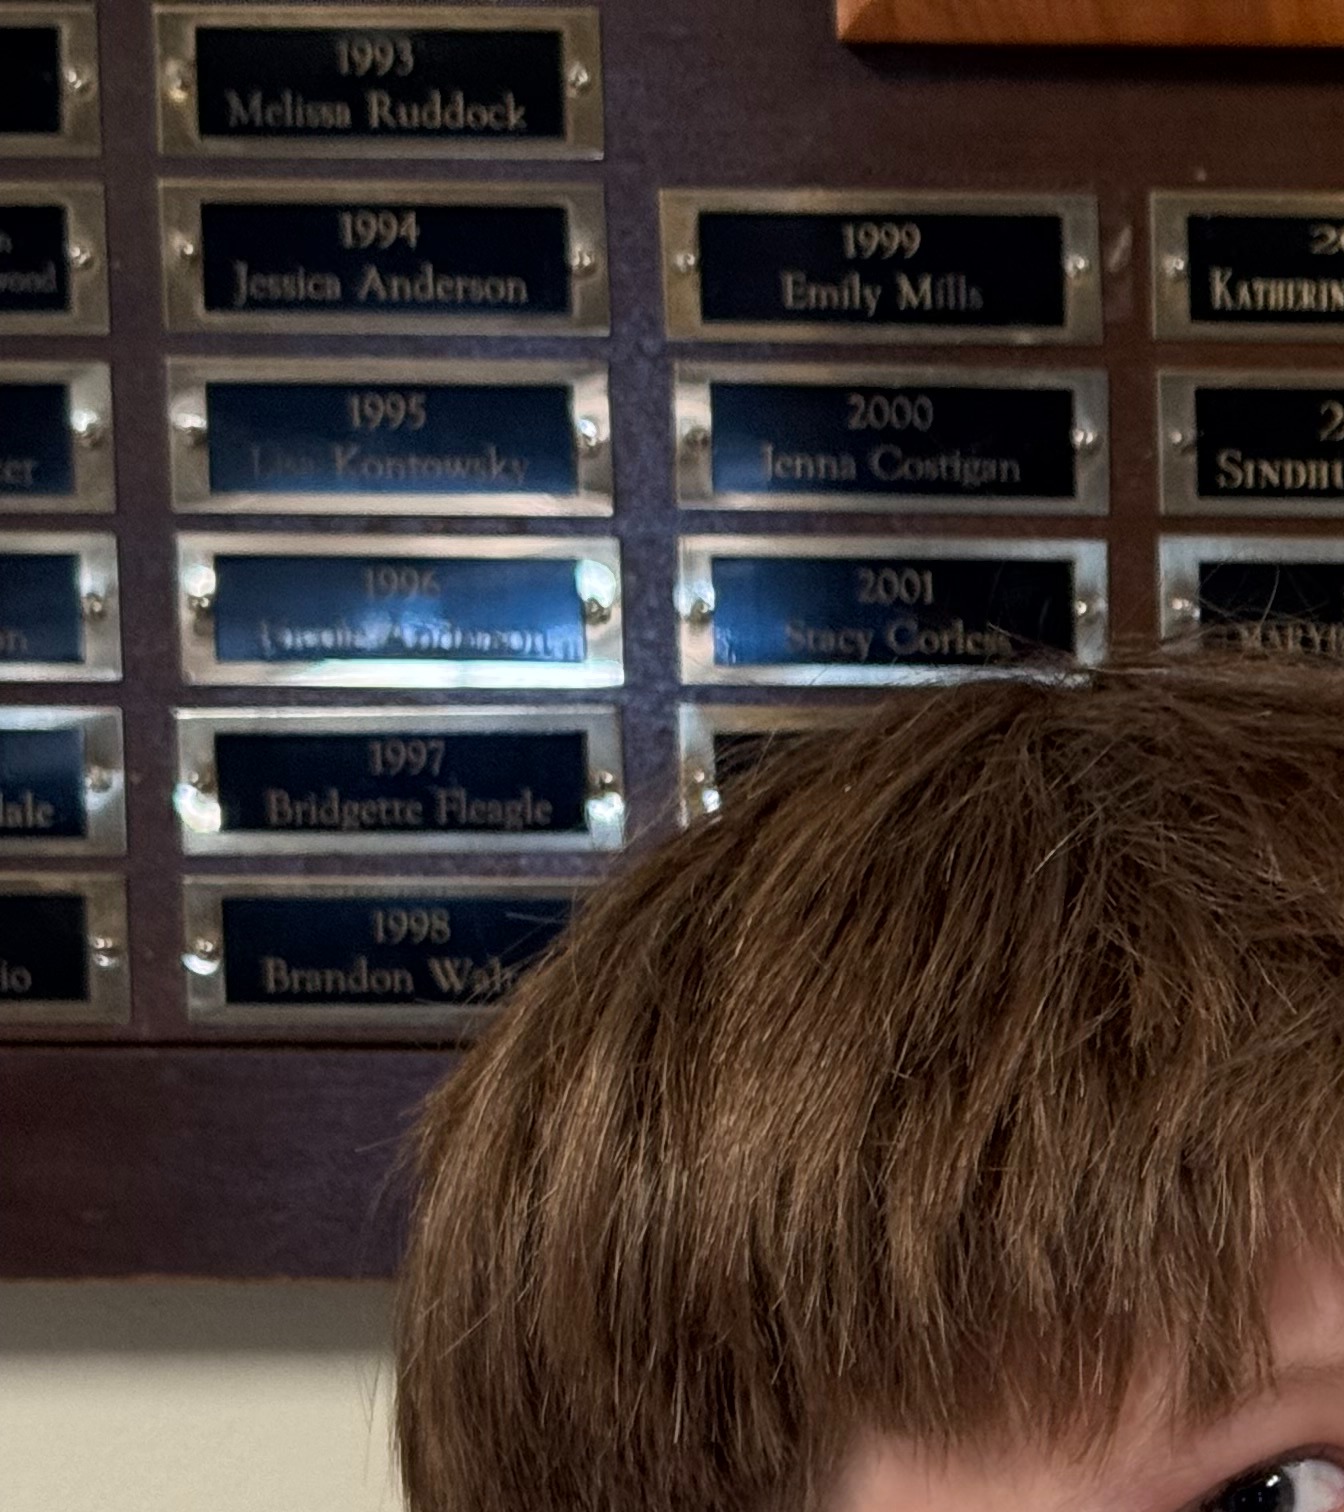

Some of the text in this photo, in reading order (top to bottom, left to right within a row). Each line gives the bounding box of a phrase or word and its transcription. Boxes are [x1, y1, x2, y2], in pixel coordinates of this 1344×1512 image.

[337, 38, 415, 77] 1993
[226, 89, 529, 131] Melissa Ruddock
[338, 209, 421, 250] 1994
[840, 221, 922, 260] 1999
[233, 260, 530, 309] Jessica Anderson
[781, 269, 985, 317] Emily Mills
[347, 390, 428, 431] 1995
[846, 394, 934, 433] 2000
[760, 442, 1022, 489] Jenna Costigan
[362, 564, 442, 600] 1996
[856, 567, 935, 606] 2001
[783, 618, 875, 665] Stacy
[367, 738, 447, 778] 1997
[264, 789, 554, 832] Bridgette Fleagle
[369, 909, 452, 946] 1998
[262, 955, 416, 996] Brandon
